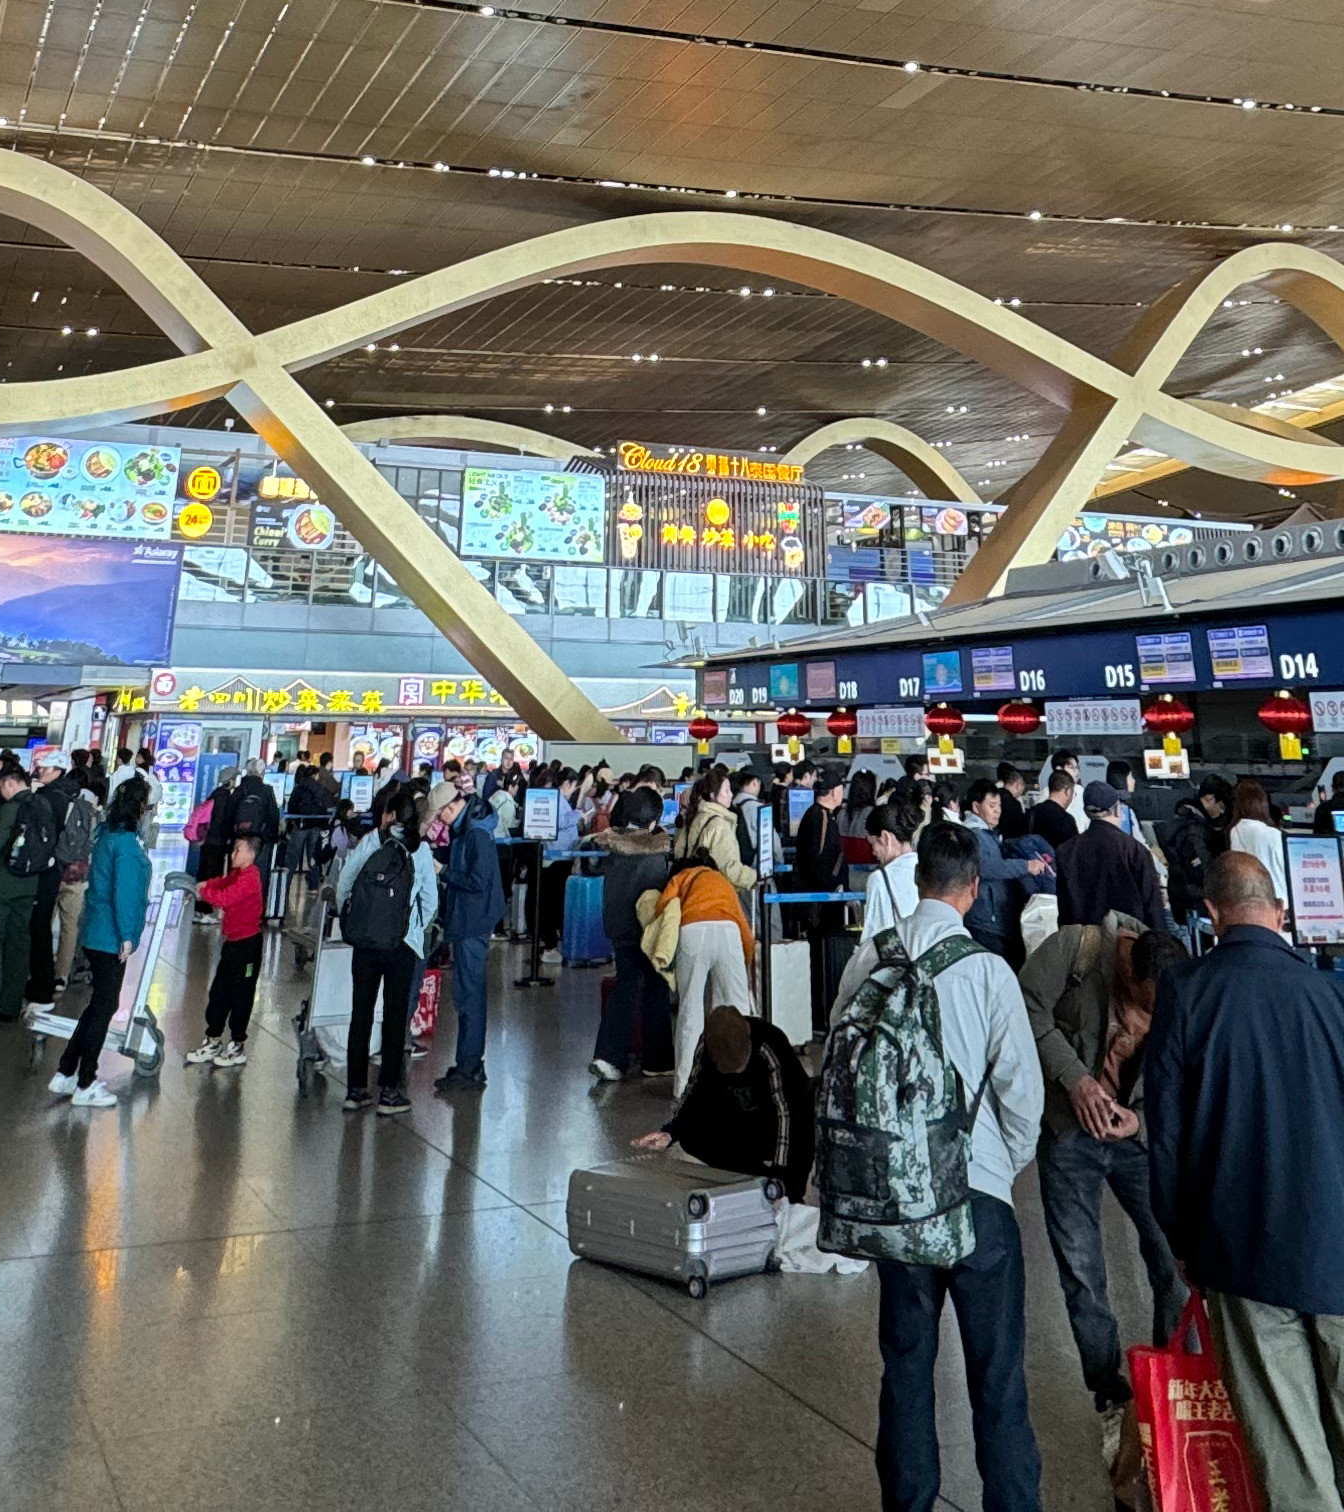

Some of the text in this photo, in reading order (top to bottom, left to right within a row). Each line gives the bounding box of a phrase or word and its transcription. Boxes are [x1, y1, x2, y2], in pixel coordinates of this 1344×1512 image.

[619, 442, 704, 473] Cloud 18
[1105, 664, 1135, 688] D15
[1279, 653, 1319, 679] D14
[839, 681, 858, 700] D18
[899, 677, 920, 697] D17
[1020, 670, 1046, 691] D16
[729, 688, 744, 705] D20
[752, 687, 767, 705] D19
